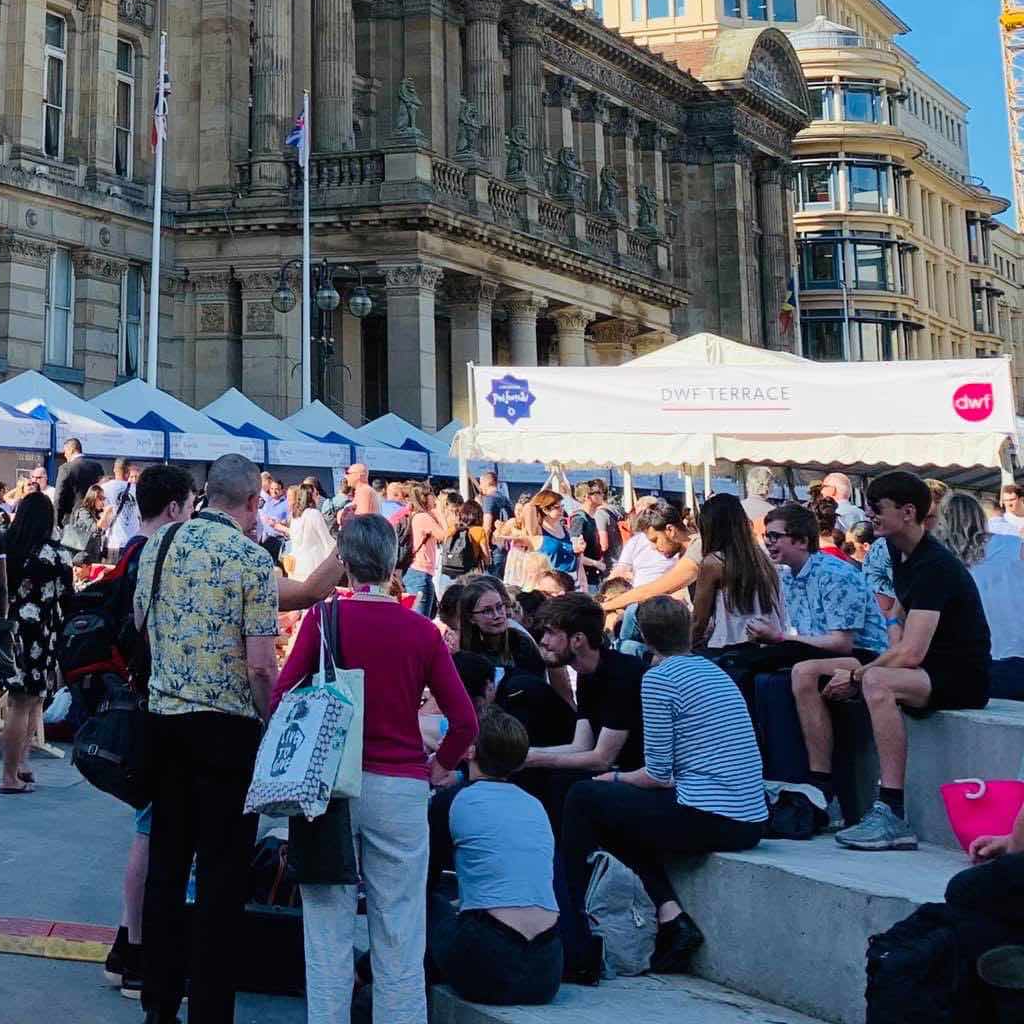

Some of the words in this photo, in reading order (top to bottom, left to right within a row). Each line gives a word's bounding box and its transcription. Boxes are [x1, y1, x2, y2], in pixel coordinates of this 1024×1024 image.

[661, 387, 702, 401] DWF
[708, 386, 792, 401] TERRACE
[954, 393, 992, 410] dwf
